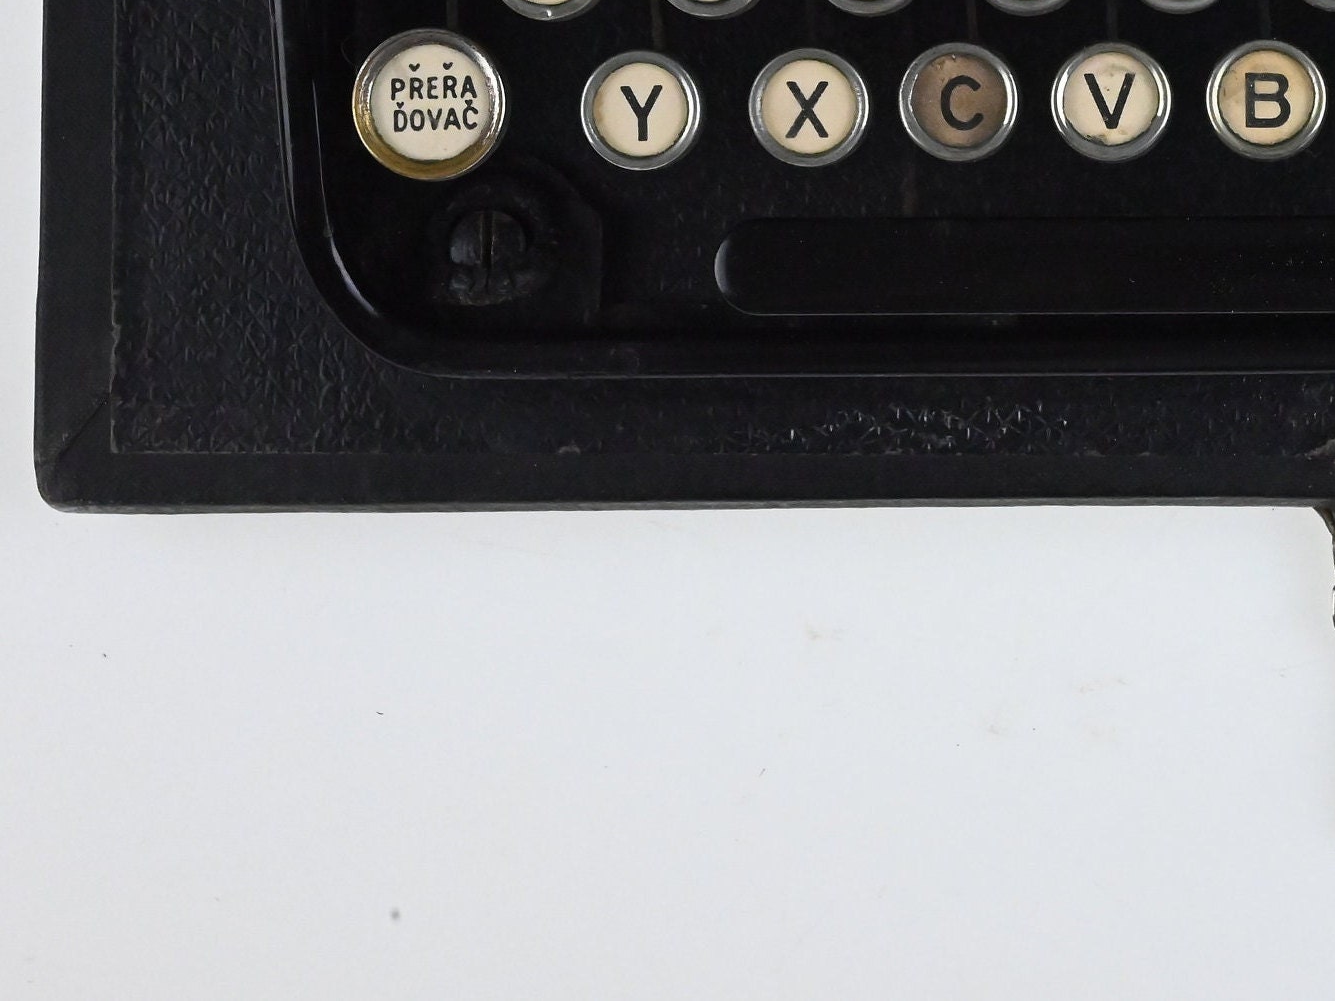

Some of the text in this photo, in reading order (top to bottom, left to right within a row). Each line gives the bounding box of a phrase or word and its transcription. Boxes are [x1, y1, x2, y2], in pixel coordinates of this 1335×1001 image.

[620, 84, 663, 142] Y
[785, 80, 829, 139] X
[940, 74, 984, 131] C
[1083, 72, 1136, 130] V
[1244, 72, 1291, 129] B
